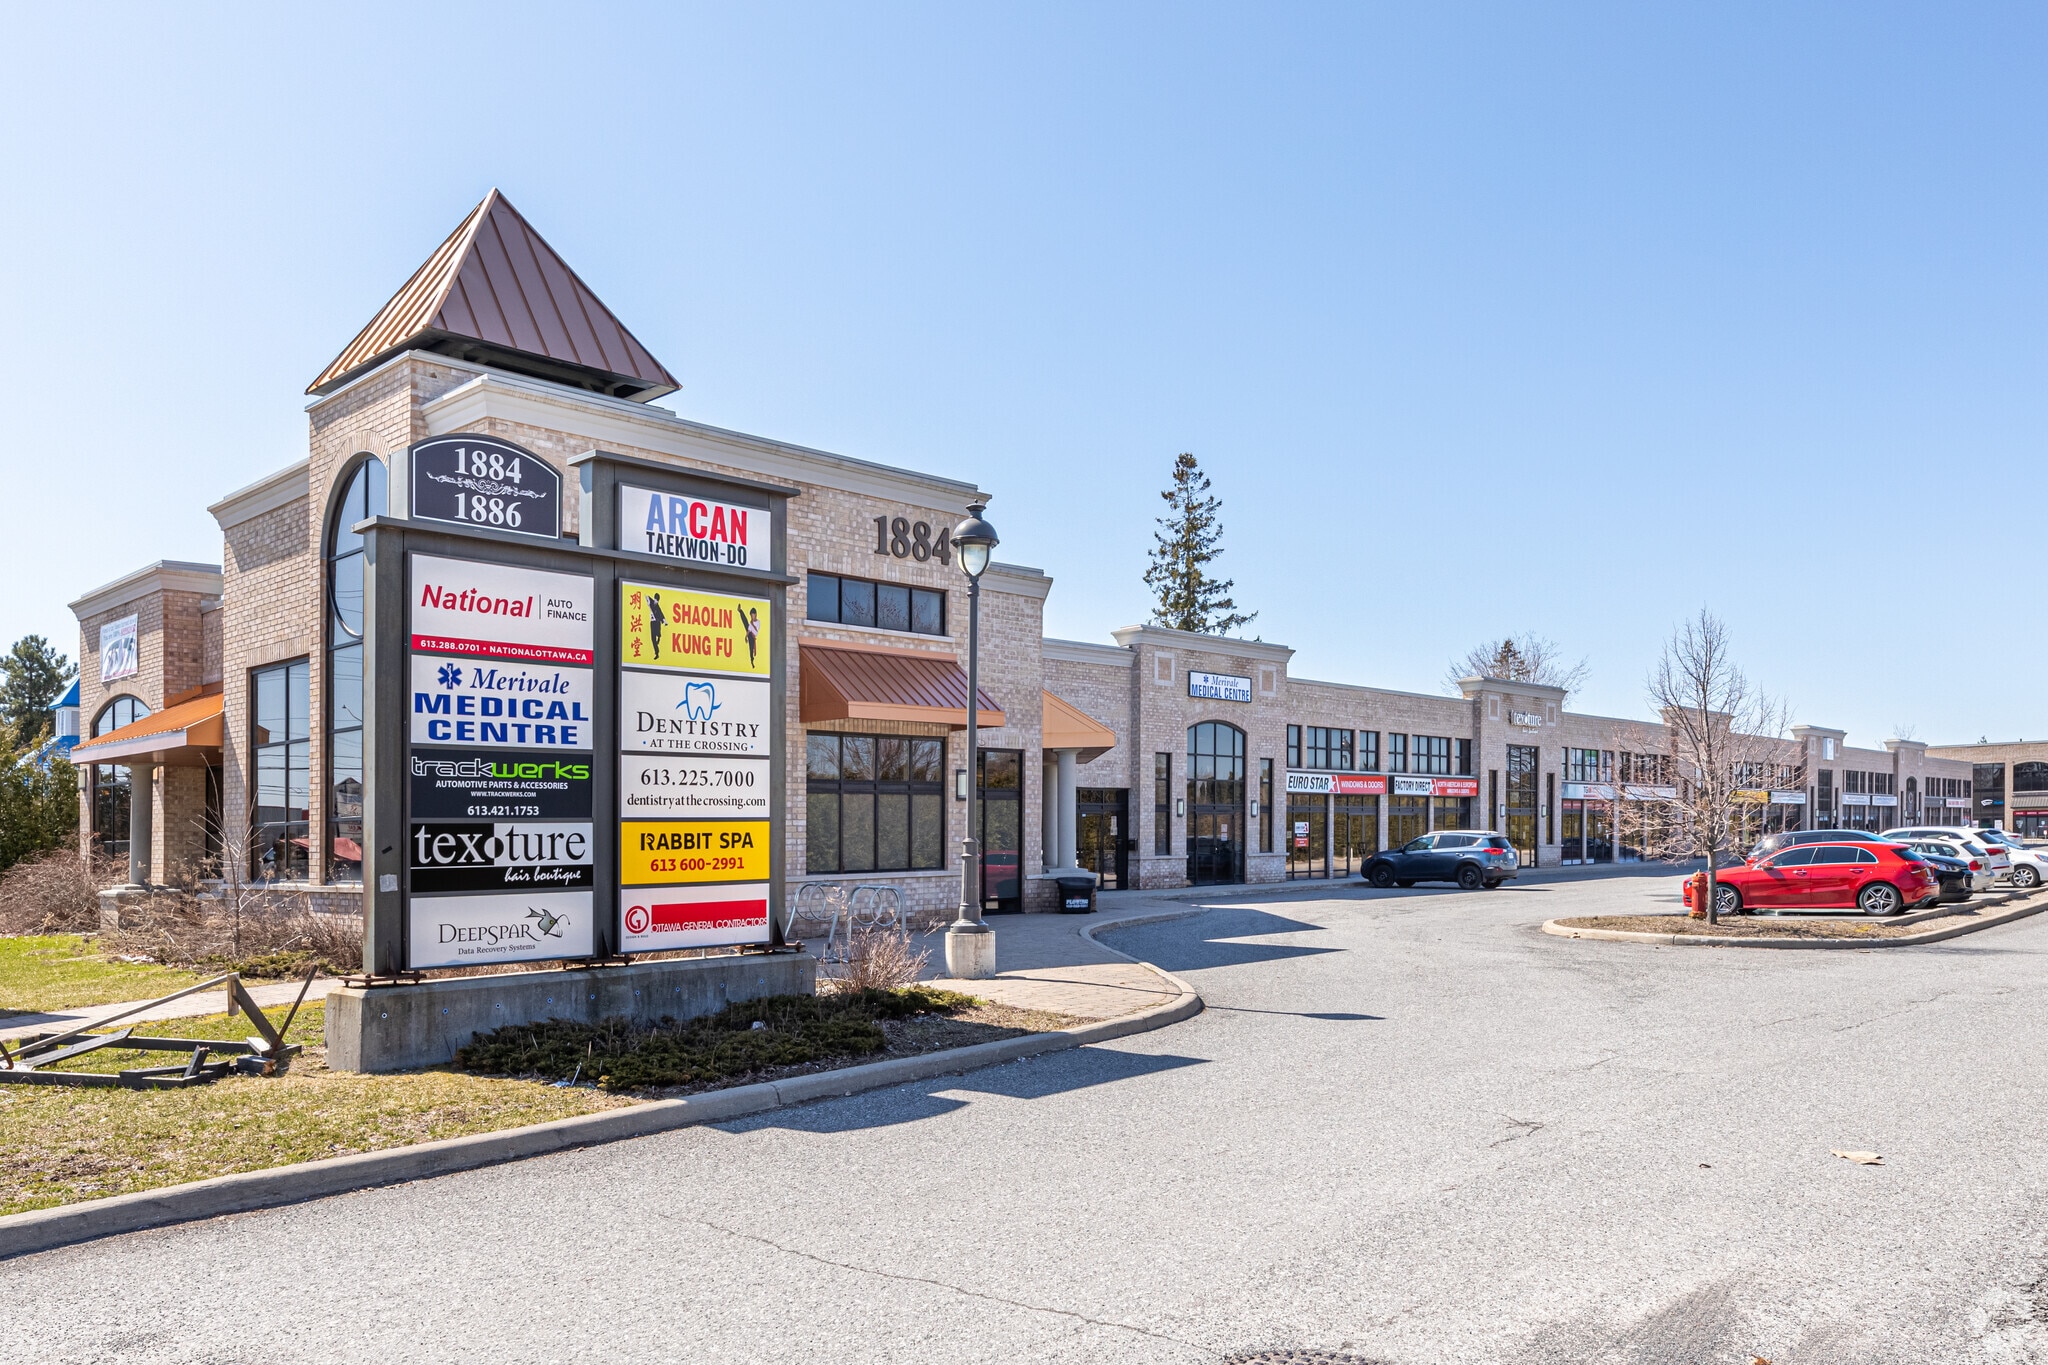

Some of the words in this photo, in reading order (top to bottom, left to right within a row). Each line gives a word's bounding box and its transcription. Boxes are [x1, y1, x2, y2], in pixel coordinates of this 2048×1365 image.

[454, 447, 522, 484] 1884
[454, 492, 521, 528] 1886
[645, 493, 747, 546] ARCAN
[646, 531, 747, 567] TAEKWON-DO
[873, 515, 951, 566] 1884
[421, 584, 533, 618] National
[547, 599, 573, 609] AUTO
[547, 610, 587, 622] FINANCE
[672, 602, 733, 629] SHAOLIN
[420, 639, 480, 652] 613.288.0701
[489, 645, 587, 661] NATIONALOTTAWA.CA
[672, 633, 711, 656] KUNG
[716, 637, 733, 658] FU
[470, 667, 570, 694] Merivale
[1211, 676, 1239, 688] Merivale
[1191, 684, 1222, 698] MEDICAL
[1224, 687, 1250, 701] CENTRE
[414, 692, 589, 721] MEDICAL
[428, 719, 578, 745] CENTRE
[636, 711, 760, 738] DENTISTRY
[650, 739, 664, 748] AT
[667, 739, 691, 749] THE
[694, 740, 748, 751] CROSSING
[411, 756, 590, 780] trackwerks
[641, 768, 755, 787] 613.225.7000
[436, 780, 487, 789] AUTOMOTIVE
[489, 781, 512, 789] PARTS
[521, 782, 569, 790] ACCESSORIES
[1288, 775, 1309, 789] EURO
[1310, 776, 1330, 790] STAR
[1341, 780, 1363, 788] WINDOWS
[1368, 781, 1384, 789] DOORS
[1395, 780, 1415, 791] FACTORY
[1415, 781, 1431, 792] DIRECT
[627, 793, 766, 809] dentistryatthecrossing.com
[467, 806, 540, 816] 613.421.1753
[640, 832, 713, 851] RABBIT
[719, 832, 754, 849] SPA
[650, 858, 676, 872] 613
[680, 857, 745, 871] 600-2991
[504, 867, 530, 882] hair
[534, 866, 582, 885] boutique
[651, 922, 681, 933] OTTAWA
[682, 920, 715, 931] GENERAL
[716, 917, 767, 929] CONTRACTORS
[476, 945, 507, 955] Recovery
[509, 943, 536, 953] Systems
